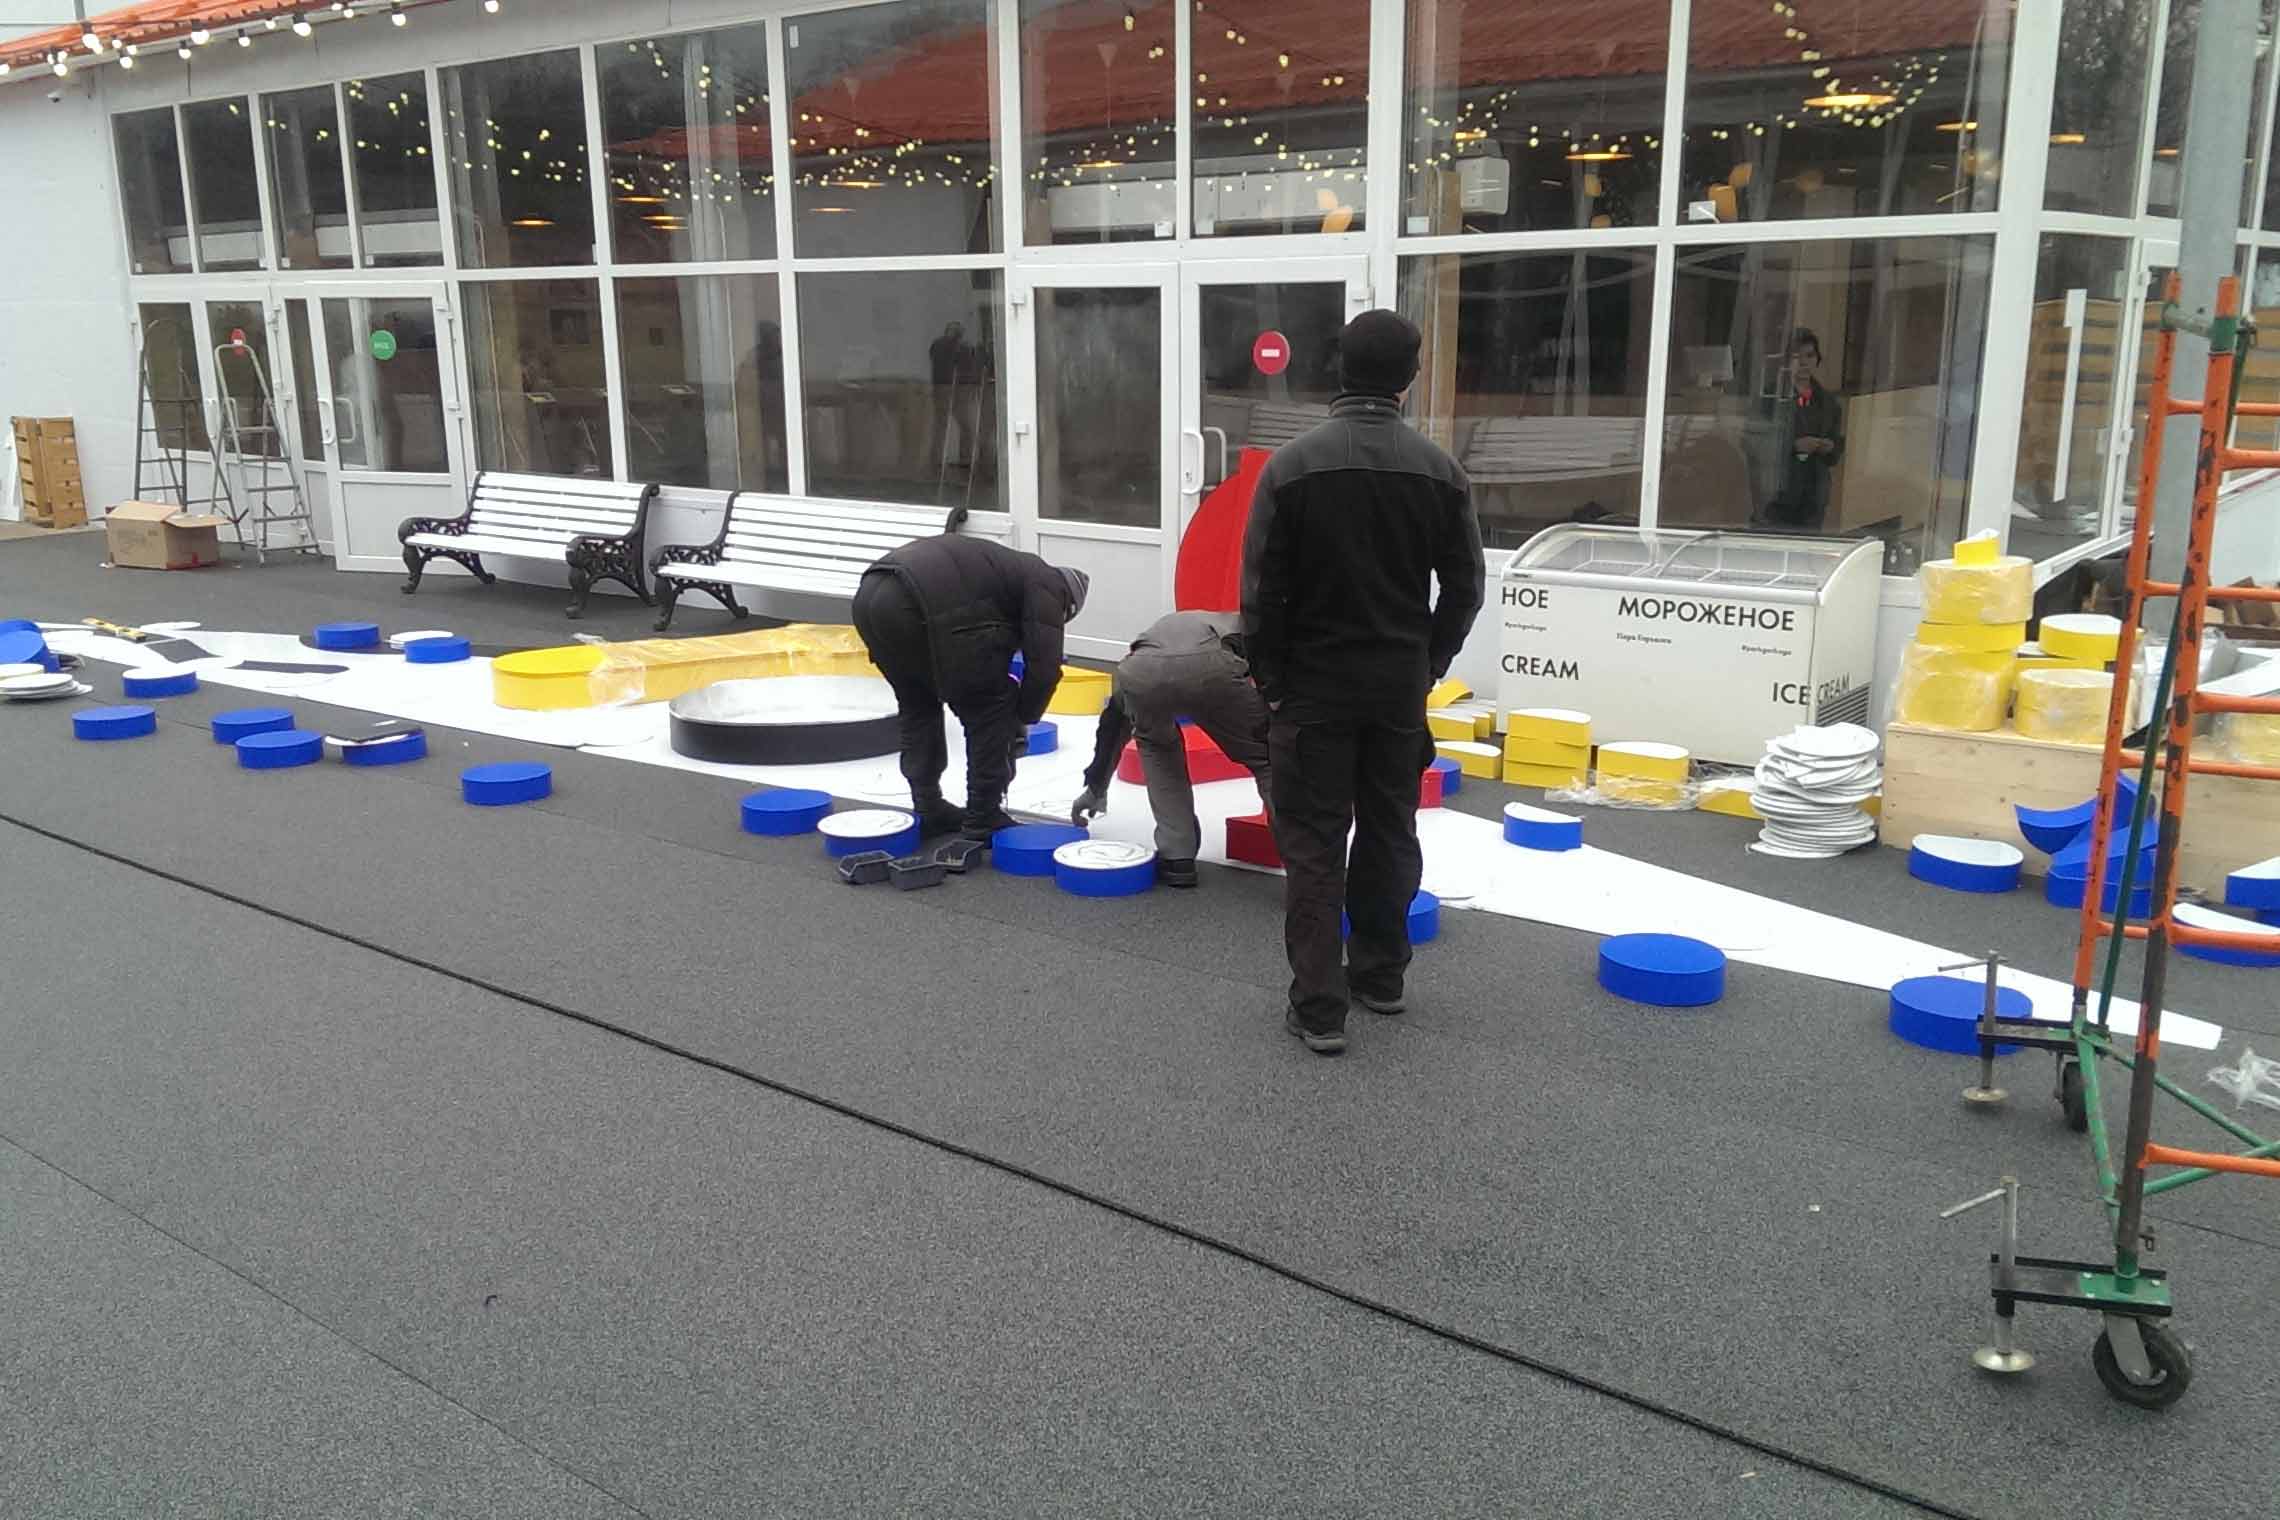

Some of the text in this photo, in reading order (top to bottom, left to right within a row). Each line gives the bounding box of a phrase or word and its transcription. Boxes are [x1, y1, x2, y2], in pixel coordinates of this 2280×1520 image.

[1501, 586, 1549, 609] НОЕ
[1617, 596, 1795, 632] МОРОЖЕНОЕ
[1501, 654, 1580, 681] CREAM
[1772, 674, 1851, 706] ICE CREAM
